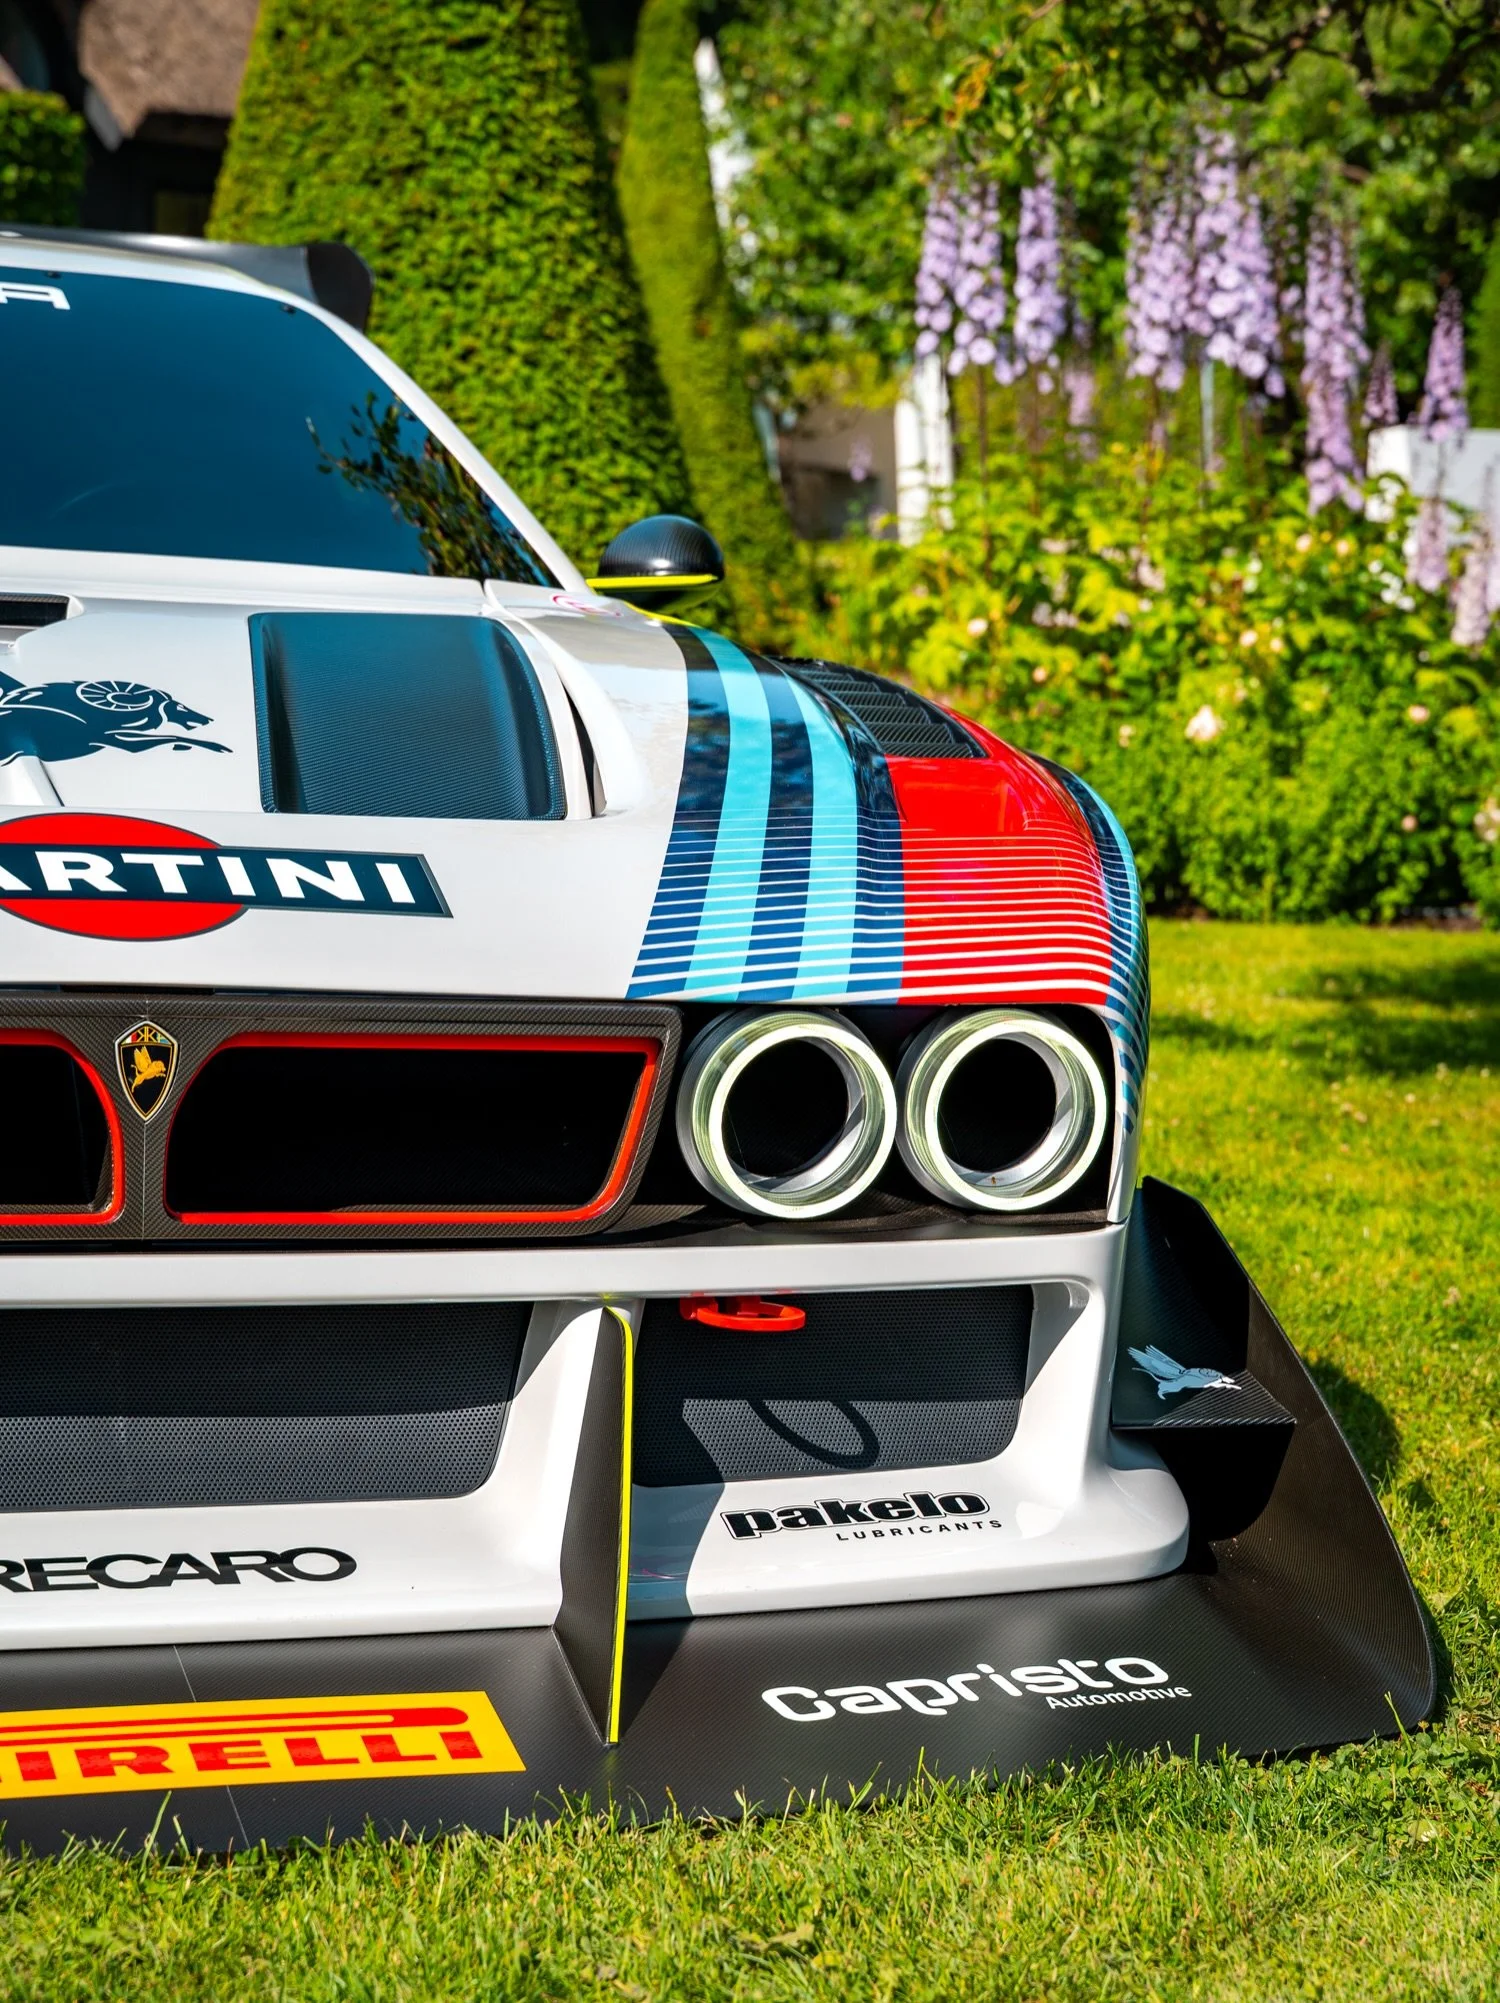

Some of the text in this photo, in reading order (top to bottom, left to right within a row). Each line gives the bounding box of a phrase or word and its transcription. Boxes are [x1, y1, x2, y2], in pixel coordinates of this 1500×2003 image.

[720, 1491, 990, 1540] pakelo
[836, 1519, 1003, 1541] LUBRICANTS
[761, 1656, 1169, 1722] Capristo
[1044, 1683, 1193, 1710] Automotive
